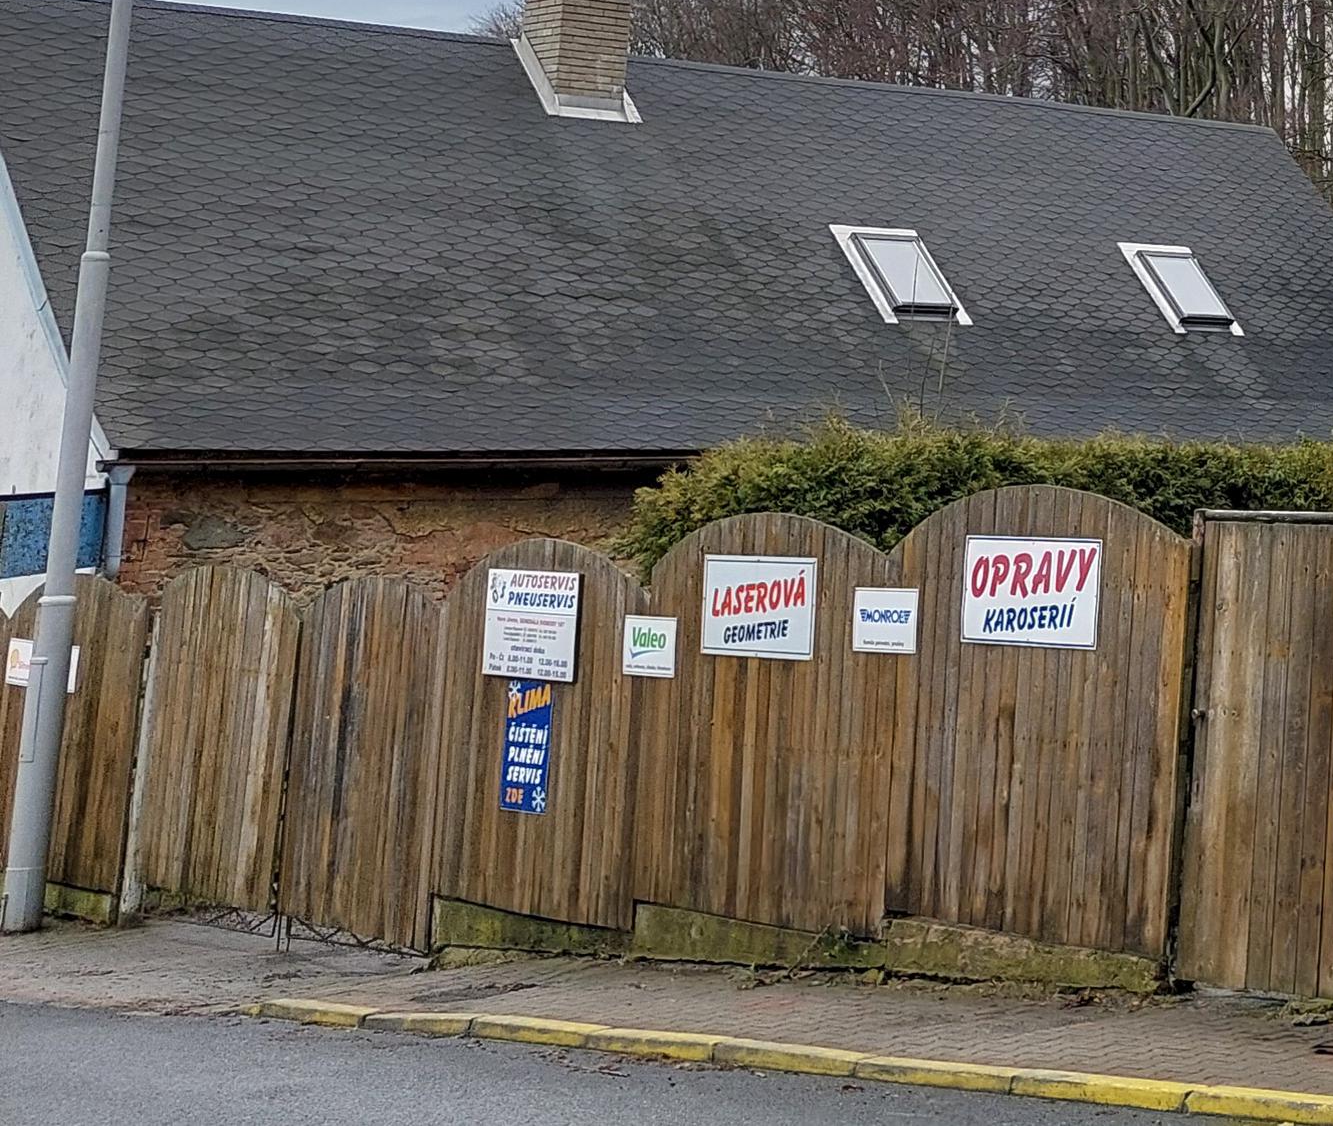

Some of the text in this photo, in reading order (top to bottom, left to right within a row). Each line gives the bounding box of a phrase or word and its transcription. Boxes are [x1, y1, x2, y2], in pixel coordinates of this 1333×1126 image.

[510, 573, 577, 592] AUTOSERVIS
[971, 547, 1098, 598] OPRAVY
[507, 591, 576, 609] PNEUSERVIS
[711, 570, 806, 617] LASEROVÁ
[865, 609, 907, 624] MONROE
[982, 596, 1077, 634] KAROSERIÍ
[632, 626, 667, 649] Valeo
[723, 619, 789, 644] GEOMETRIE
[508, 684, 551, 718] KLIMA
[508, 722, 549, 745] ČIŠTĚNÍ
[506, 766, 543, 784] SERVIS
[505, 788, 524, 803] ZDE
